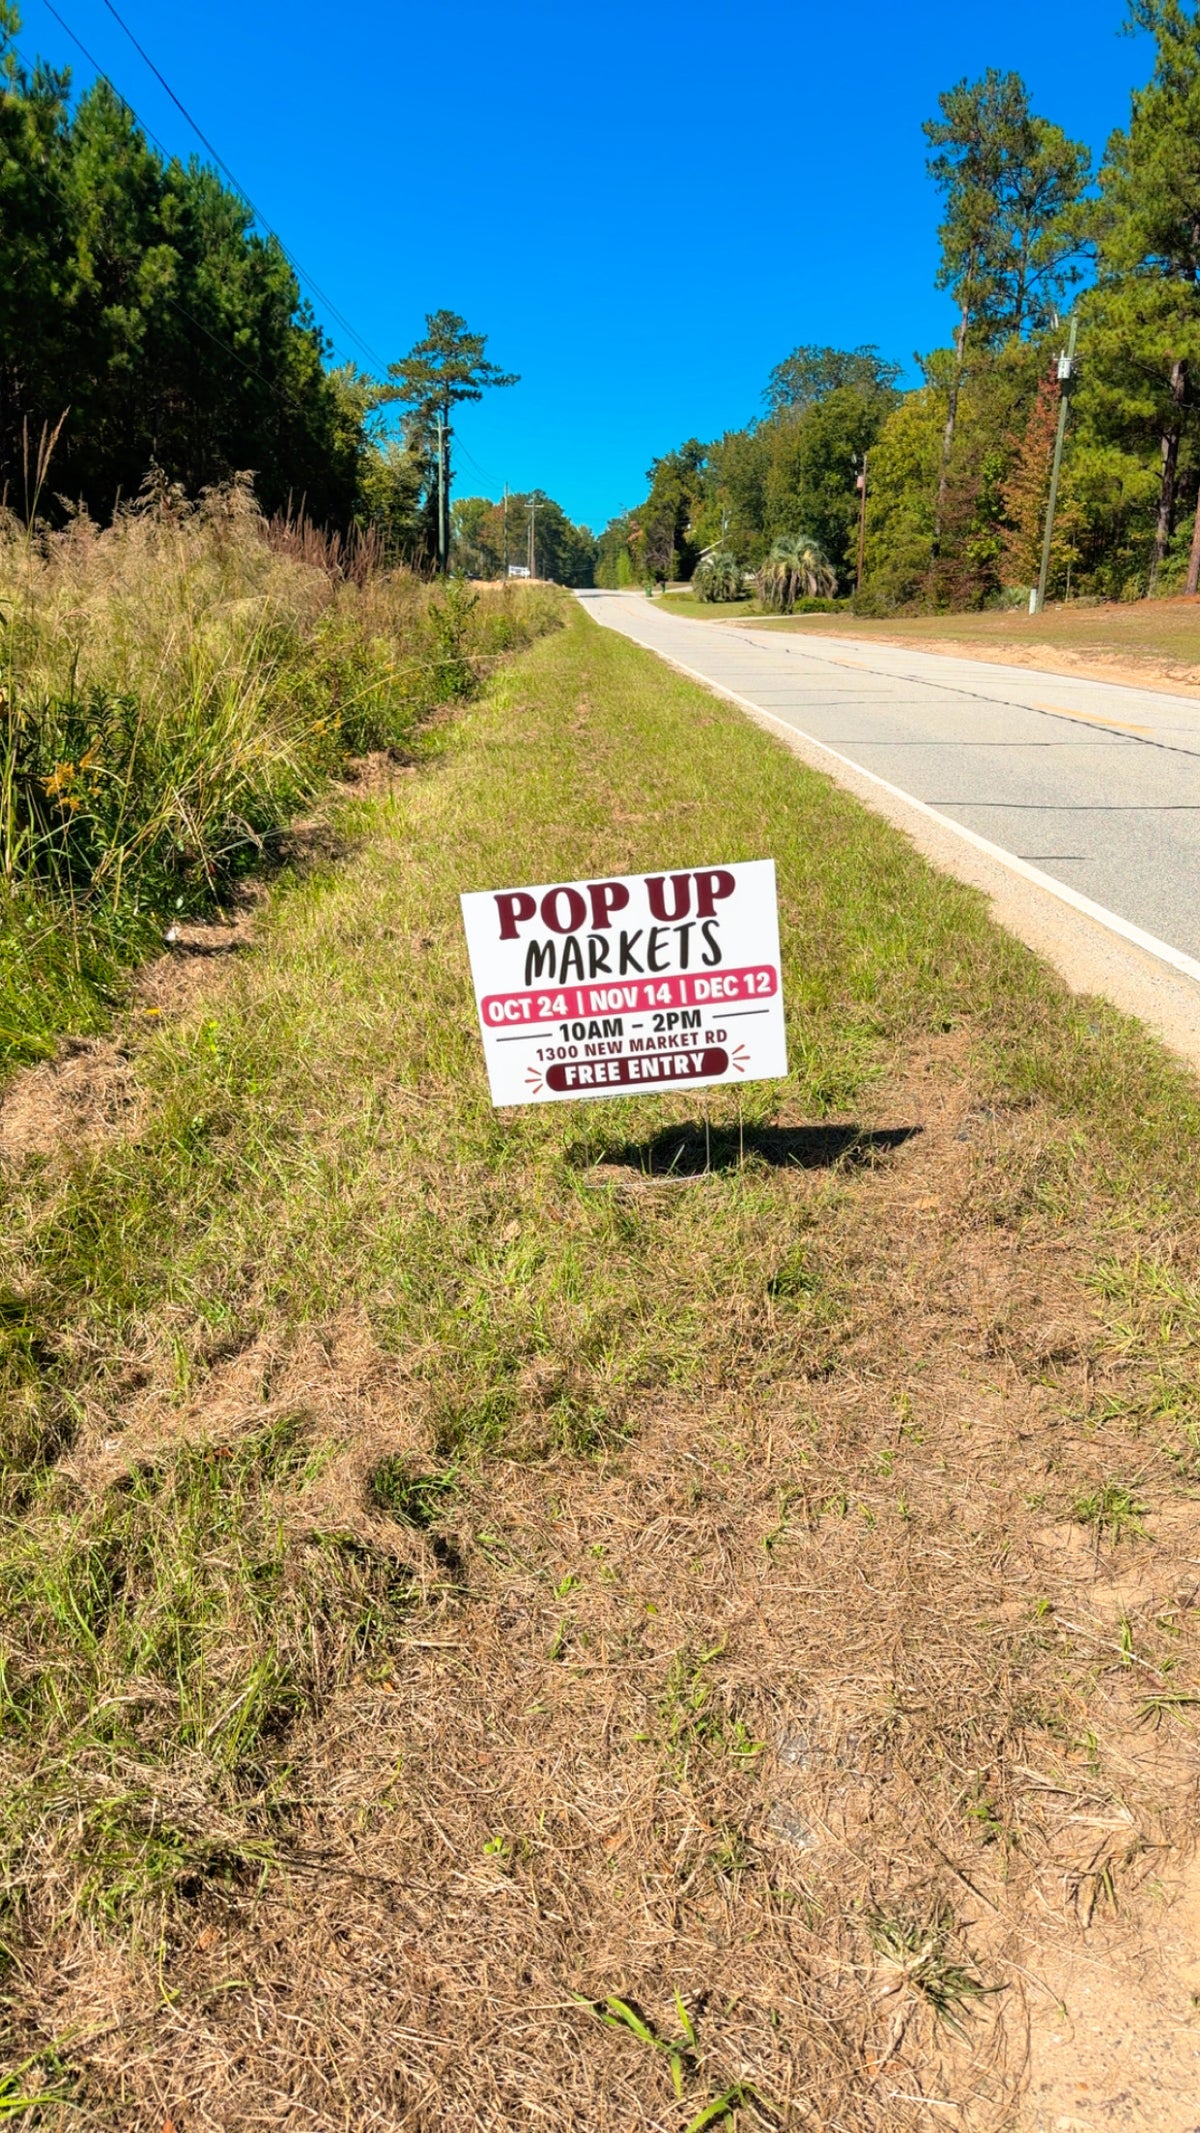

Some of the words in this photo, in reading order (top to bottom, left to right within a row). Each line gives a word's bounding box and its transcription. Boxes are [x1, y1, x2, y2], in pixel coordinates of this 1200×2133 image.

[494, 882, 630, 940] POP
[645, 870, 736, 921] UP
[525, 920, 722, 986] MARKETS
[489, 999, 532, 1022] OCT
[537, 996, 567, 1016] 24
[591, 987, 638, 1011] NOV
[643, 983, 672, 1005] 14
[694, 976, 738, 1000] DEC
[744, 972, 771, 994] 12
[537, 1046, 578, 1061] 1300
[585, 1041, 623, 1057] NEW
[629, 1033, 698, 1052] MARKET
[705, 1029, 727, 1043] RD
[560, 1018, 624, 1042] 10AM
[653, 1010, 702, 1032] 2PM
[564, 1062, 620, 1085] FREE
[628, 1053, 705, 1080] ENTRY
